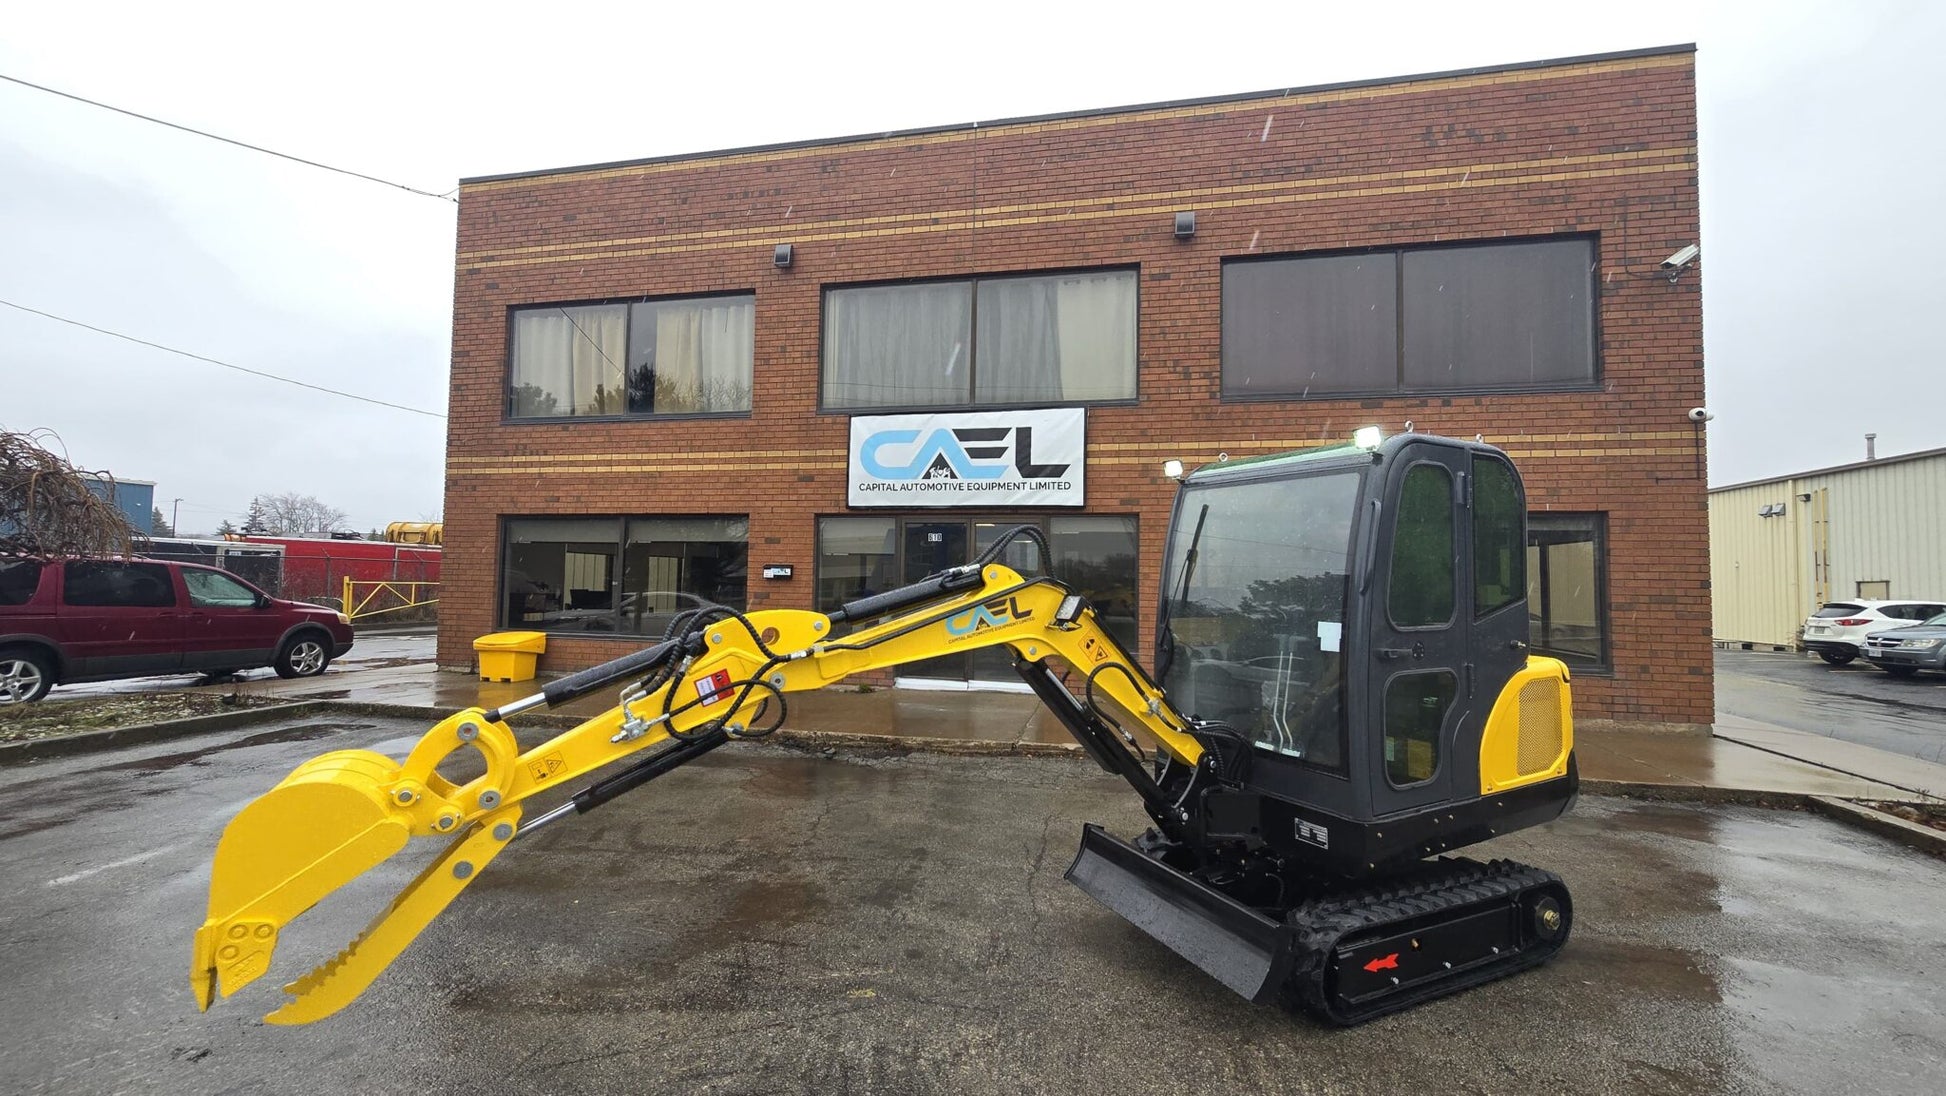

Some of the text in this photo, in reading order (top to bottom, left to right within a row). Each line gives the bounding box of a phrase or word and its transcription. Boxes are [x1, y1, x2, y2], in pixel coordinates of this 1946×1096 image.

[860, 427, 1071, 479] CAEL
[859, 481, 1072, 491] CAPITAL AUTOMOTIVE EQUIPMENT LIMITED
[945, 596, 1033, 636] CAEL
